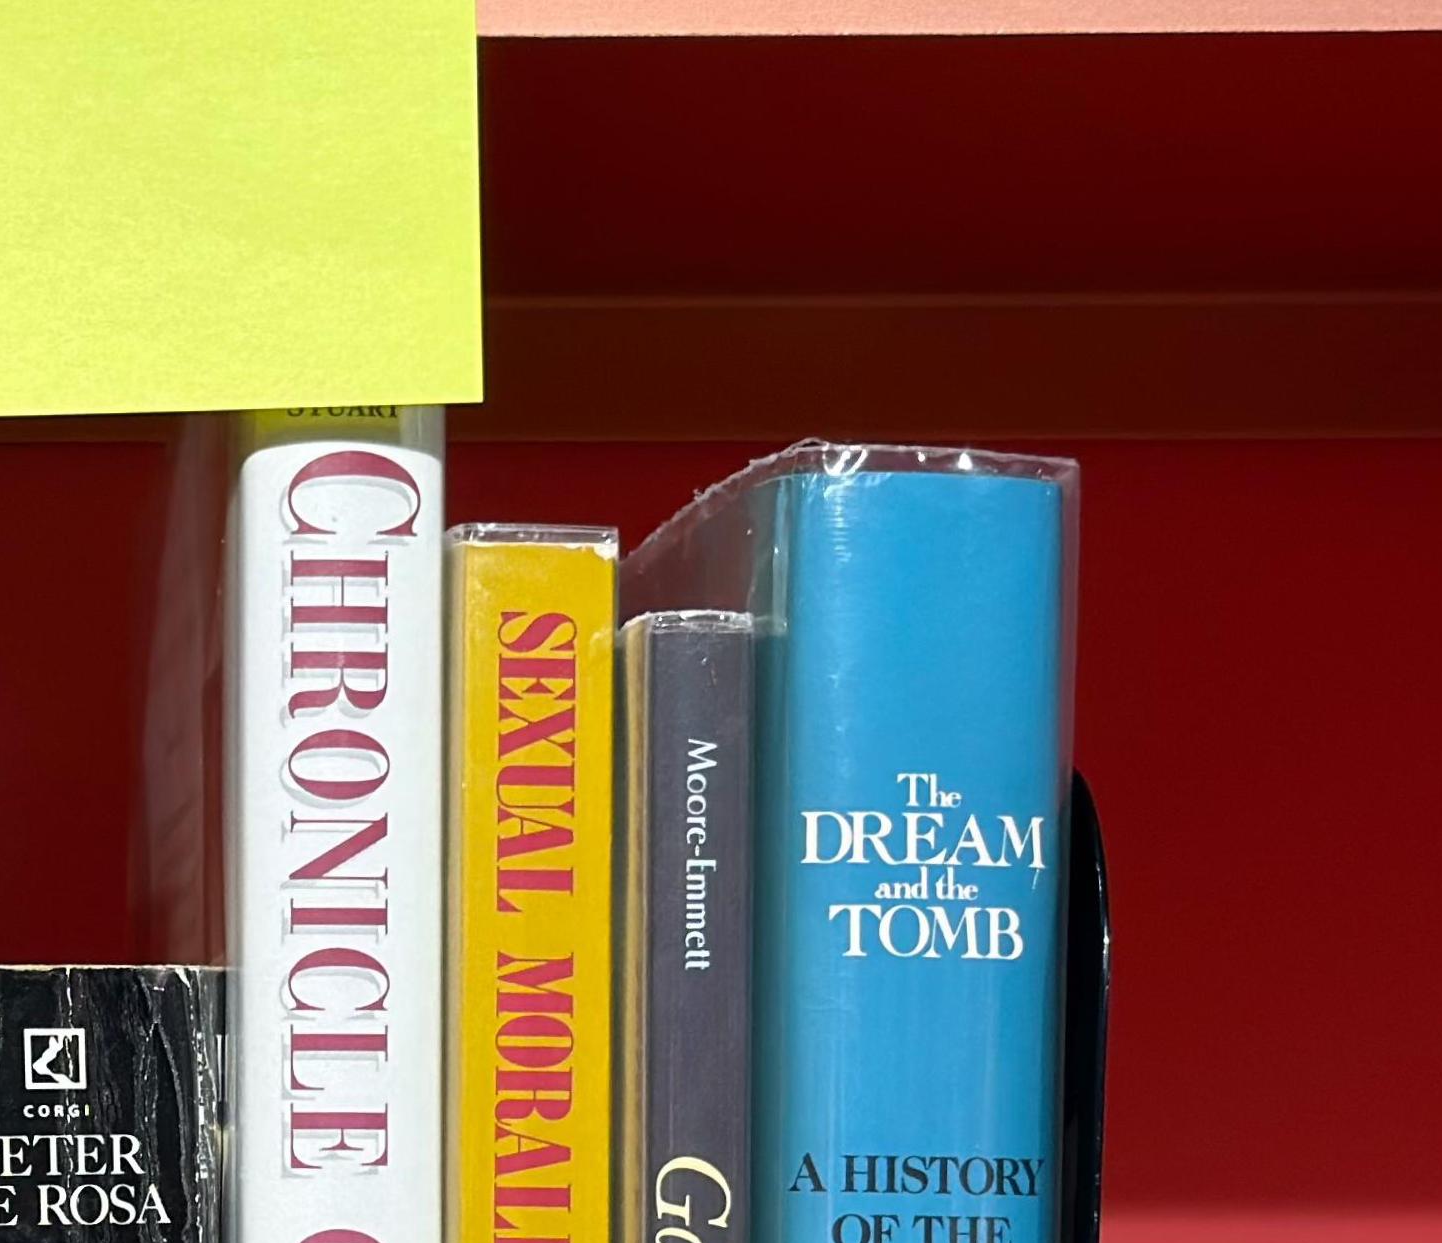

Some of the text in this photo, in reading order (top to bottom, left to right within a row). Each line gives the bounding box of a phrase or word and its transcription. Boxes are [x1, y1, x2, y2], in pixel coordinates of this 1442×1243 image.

[496, 611, 577, 914] SEXUAL
[287, 449, 421, 1169] CHRONICLE
[897, 773, 962, 807] The
[684, 738, 717, 971] Moore-Emmett
[801, 811, 1046, 869] DREAM
[874, 868, 979, 901] and the
[829, 904, 1024, 961] TOMB
[24, 1104, 91, 1116] CORGI
[789, 1153, 1044, 1197] A HISTORY
[38, 1183, 172, 1227] ROSA
